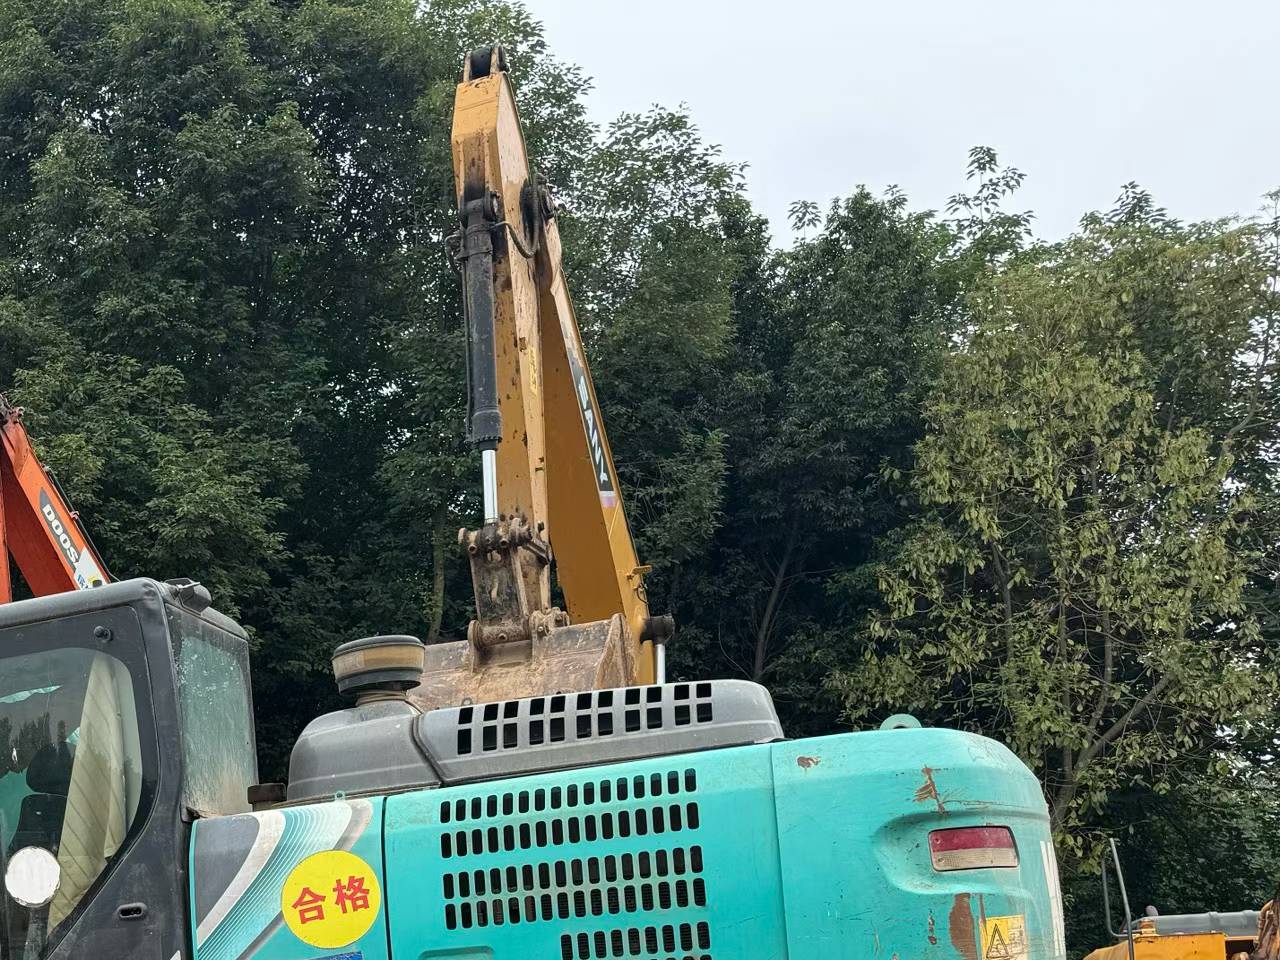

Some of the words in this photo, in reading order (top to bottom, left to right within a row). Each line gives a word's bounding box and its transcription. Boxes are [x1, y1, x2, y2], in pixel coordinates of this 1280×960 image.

[578, 375, 609, 485] SANY
[42, 503, 80, 564] DOOS
[291, 875, 370, 925] 合格
